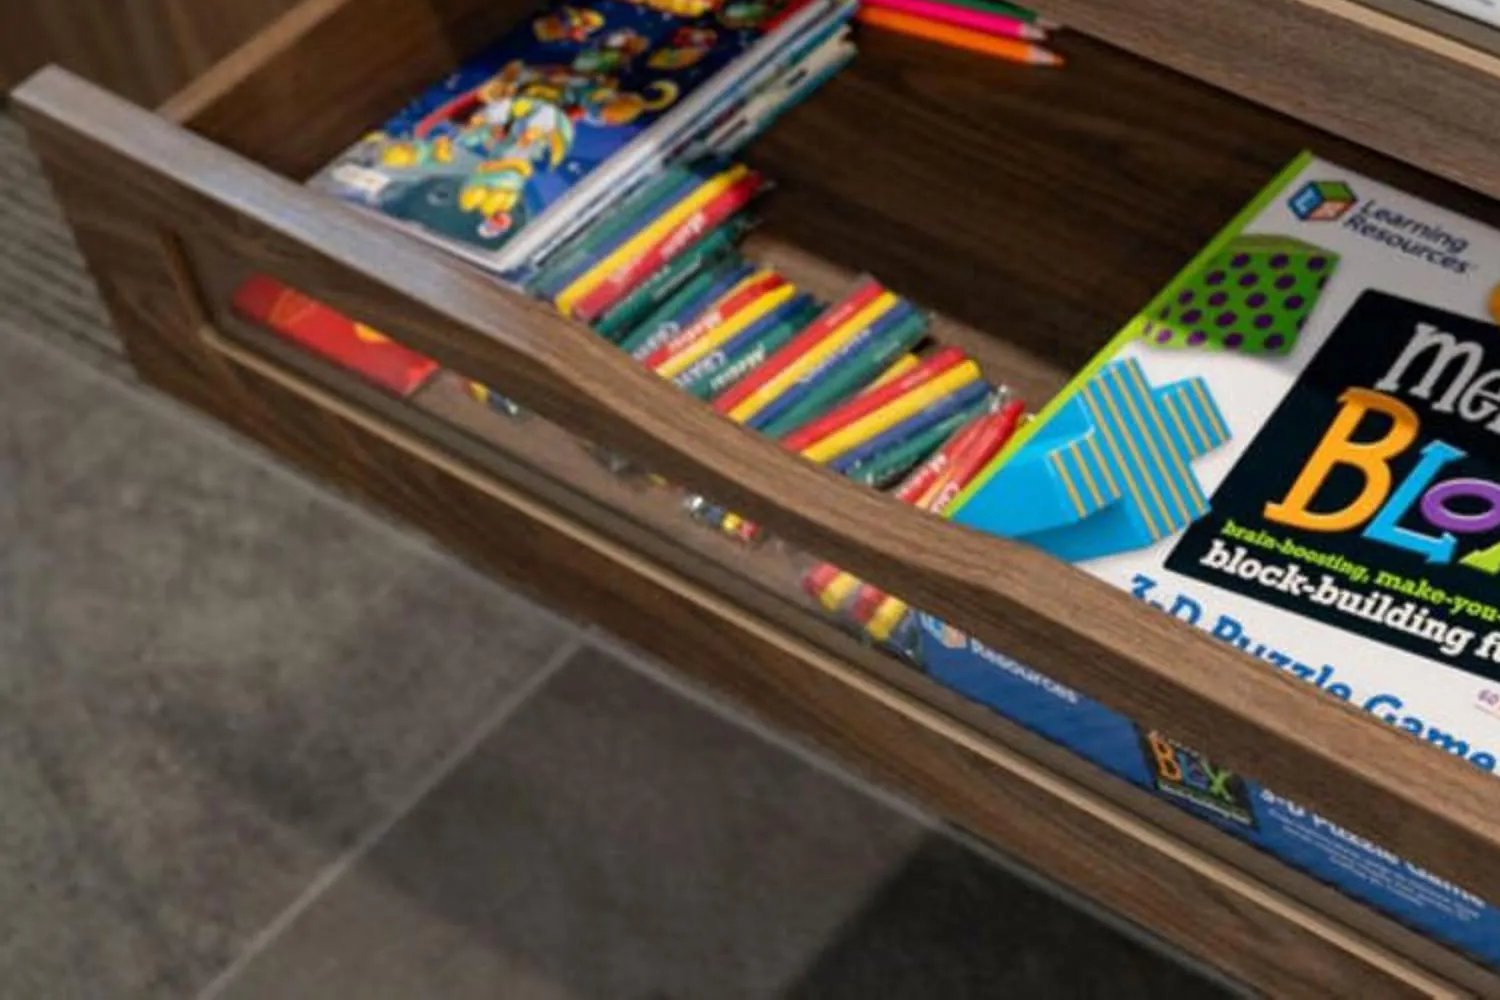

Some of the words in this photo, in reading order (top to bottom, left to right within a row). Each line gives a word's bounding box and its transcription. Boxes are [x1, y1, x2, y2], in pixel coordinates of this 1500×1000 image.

[1342, 213, 1472, 274] Resources
[1359, 199, 1469, 254] Learning
[1221, 519, 1371, 583] brain-boosting,
[1199, 538, 1475, 657] block-building
